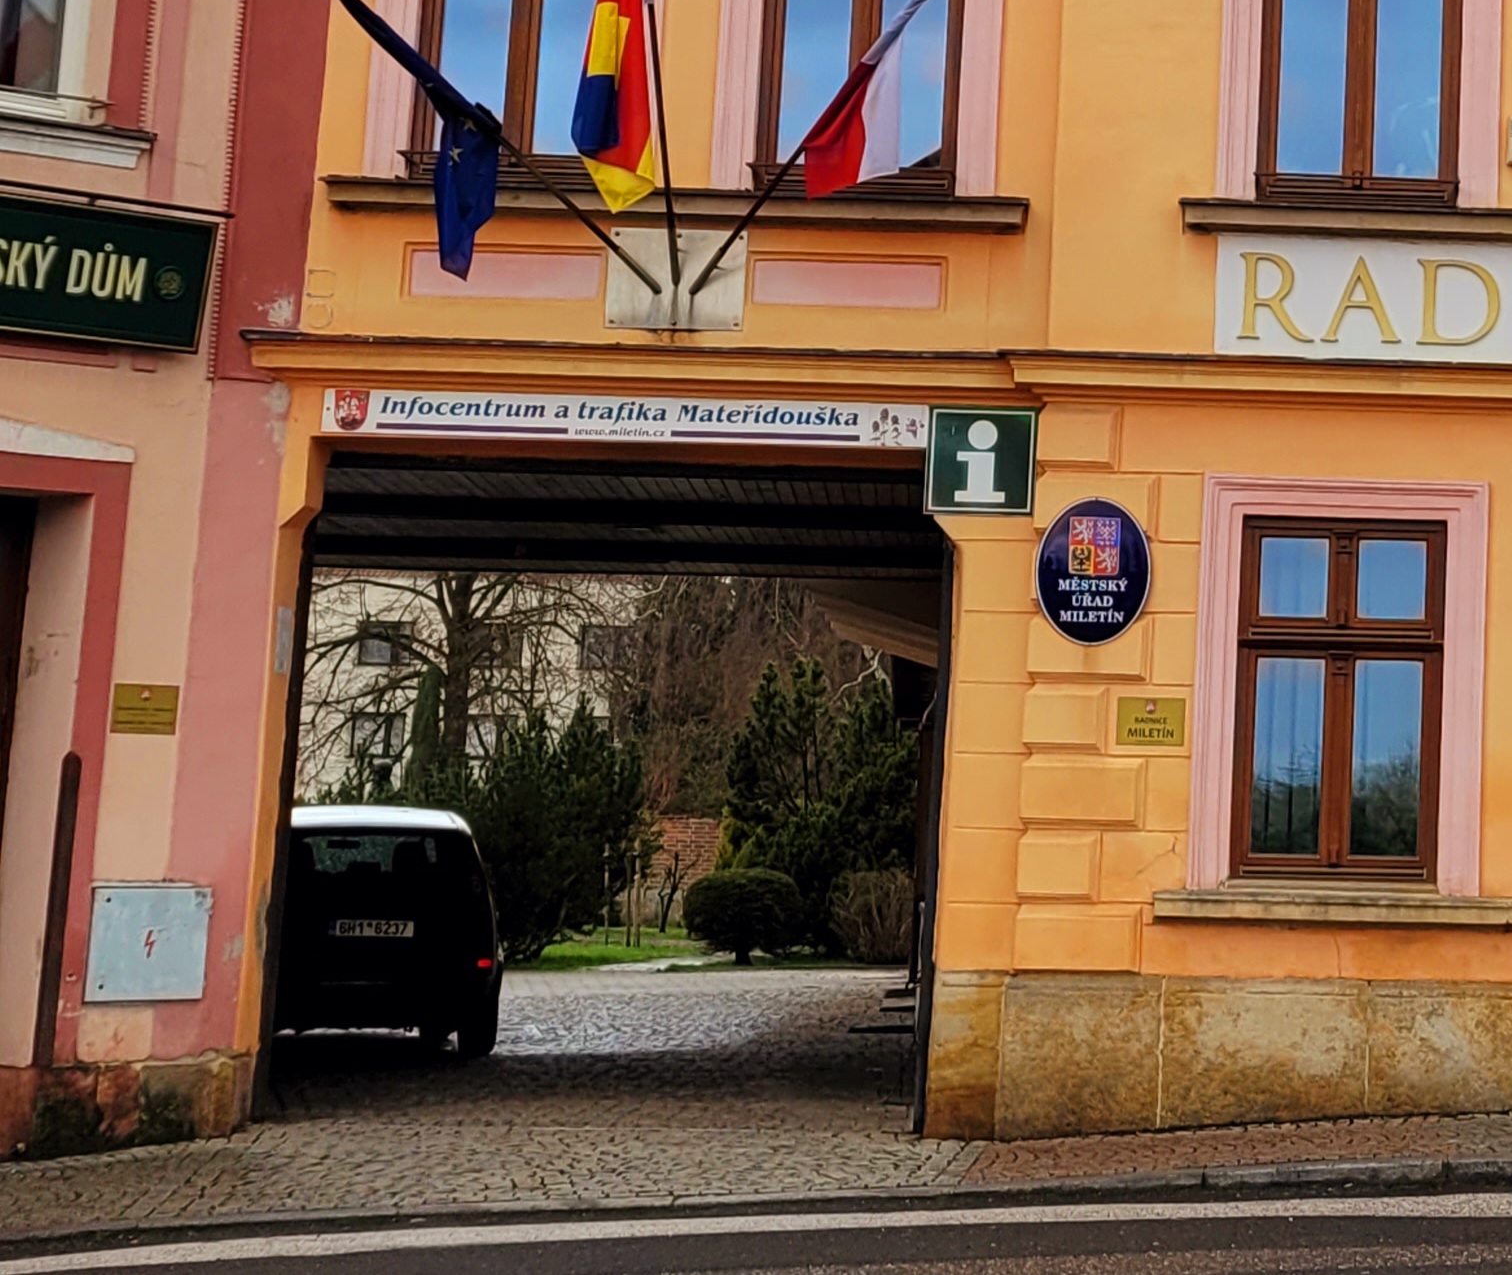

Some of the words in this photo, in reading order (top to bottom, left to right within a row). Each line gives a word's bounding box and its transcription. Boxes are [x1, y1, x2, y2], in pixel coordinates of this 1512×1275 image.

[65, 242, 148, 302] DŮM
[379, 395, 546, 420] Infocentrum
[554, 405, 569, 419] a
[676, 403, 860, 427] Mateřídouška
[1058, 576, 1128, 592] MĚSTSKÝ
[1071, 592, 1114, 607] ÚŘAD
[1059, 608, 1124, 623] MILETÍN
[1126, 726, 1175, 739] MILETÍN
